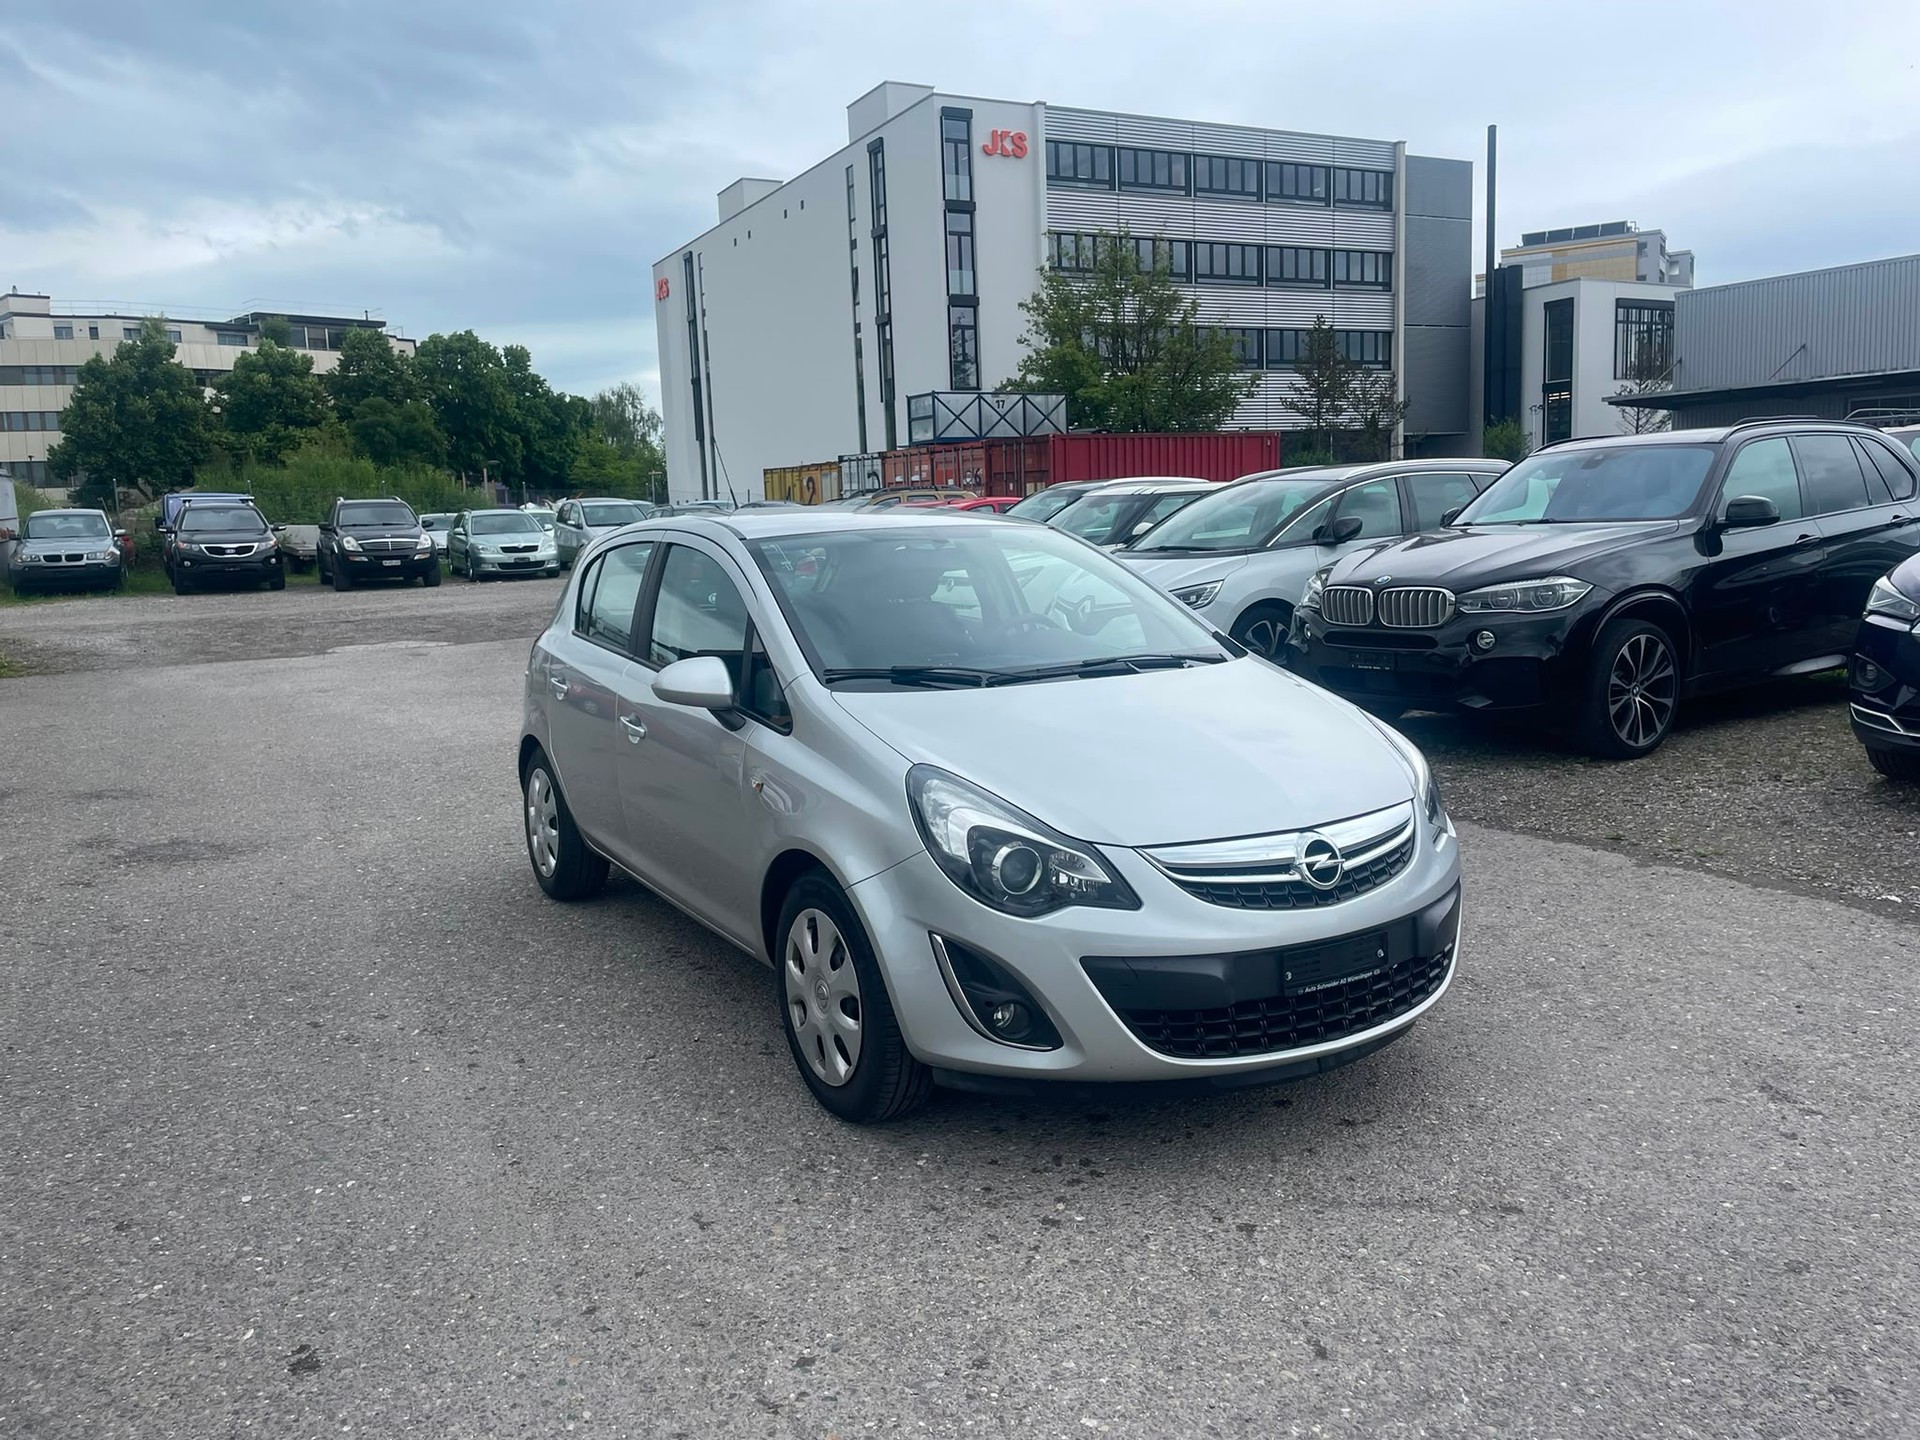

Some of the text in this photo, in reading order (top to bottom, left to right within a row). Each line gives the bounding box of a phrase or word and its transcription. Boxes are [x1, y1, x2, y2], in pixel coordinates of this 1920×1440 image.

[982, 129, 1028, 158] JKS
[995, 399, 1005, 409] 17
[1316, 980, 1340, 990] Schneider
